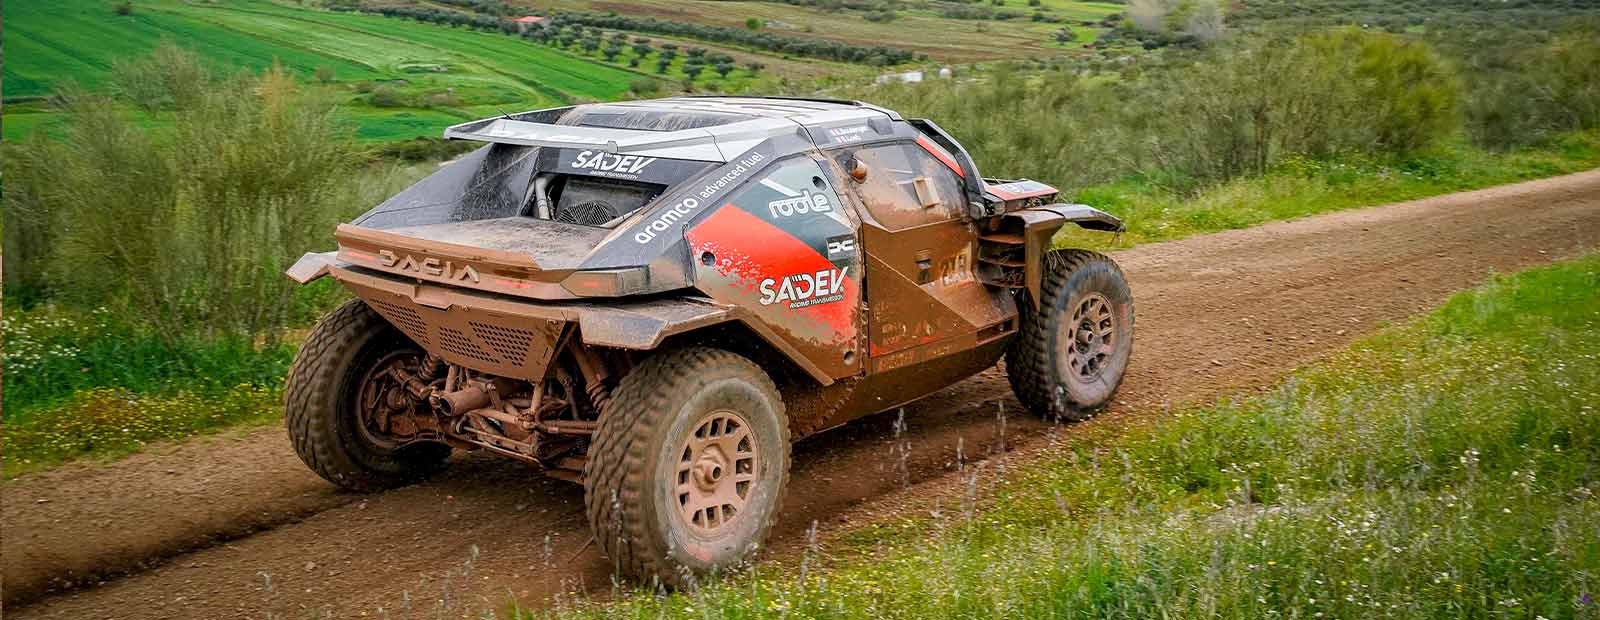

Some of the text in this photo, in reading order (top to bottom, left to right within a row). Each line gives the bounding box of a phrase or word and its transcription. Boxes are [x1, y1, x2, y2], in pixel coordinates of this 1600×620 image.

[571, 150, 657, 174] SADEV
[635, 151, 763, 244] aramco advanced fuel
[379, 249, 480, 283] DACIA
[759, 266, 848, 305] SADEV
